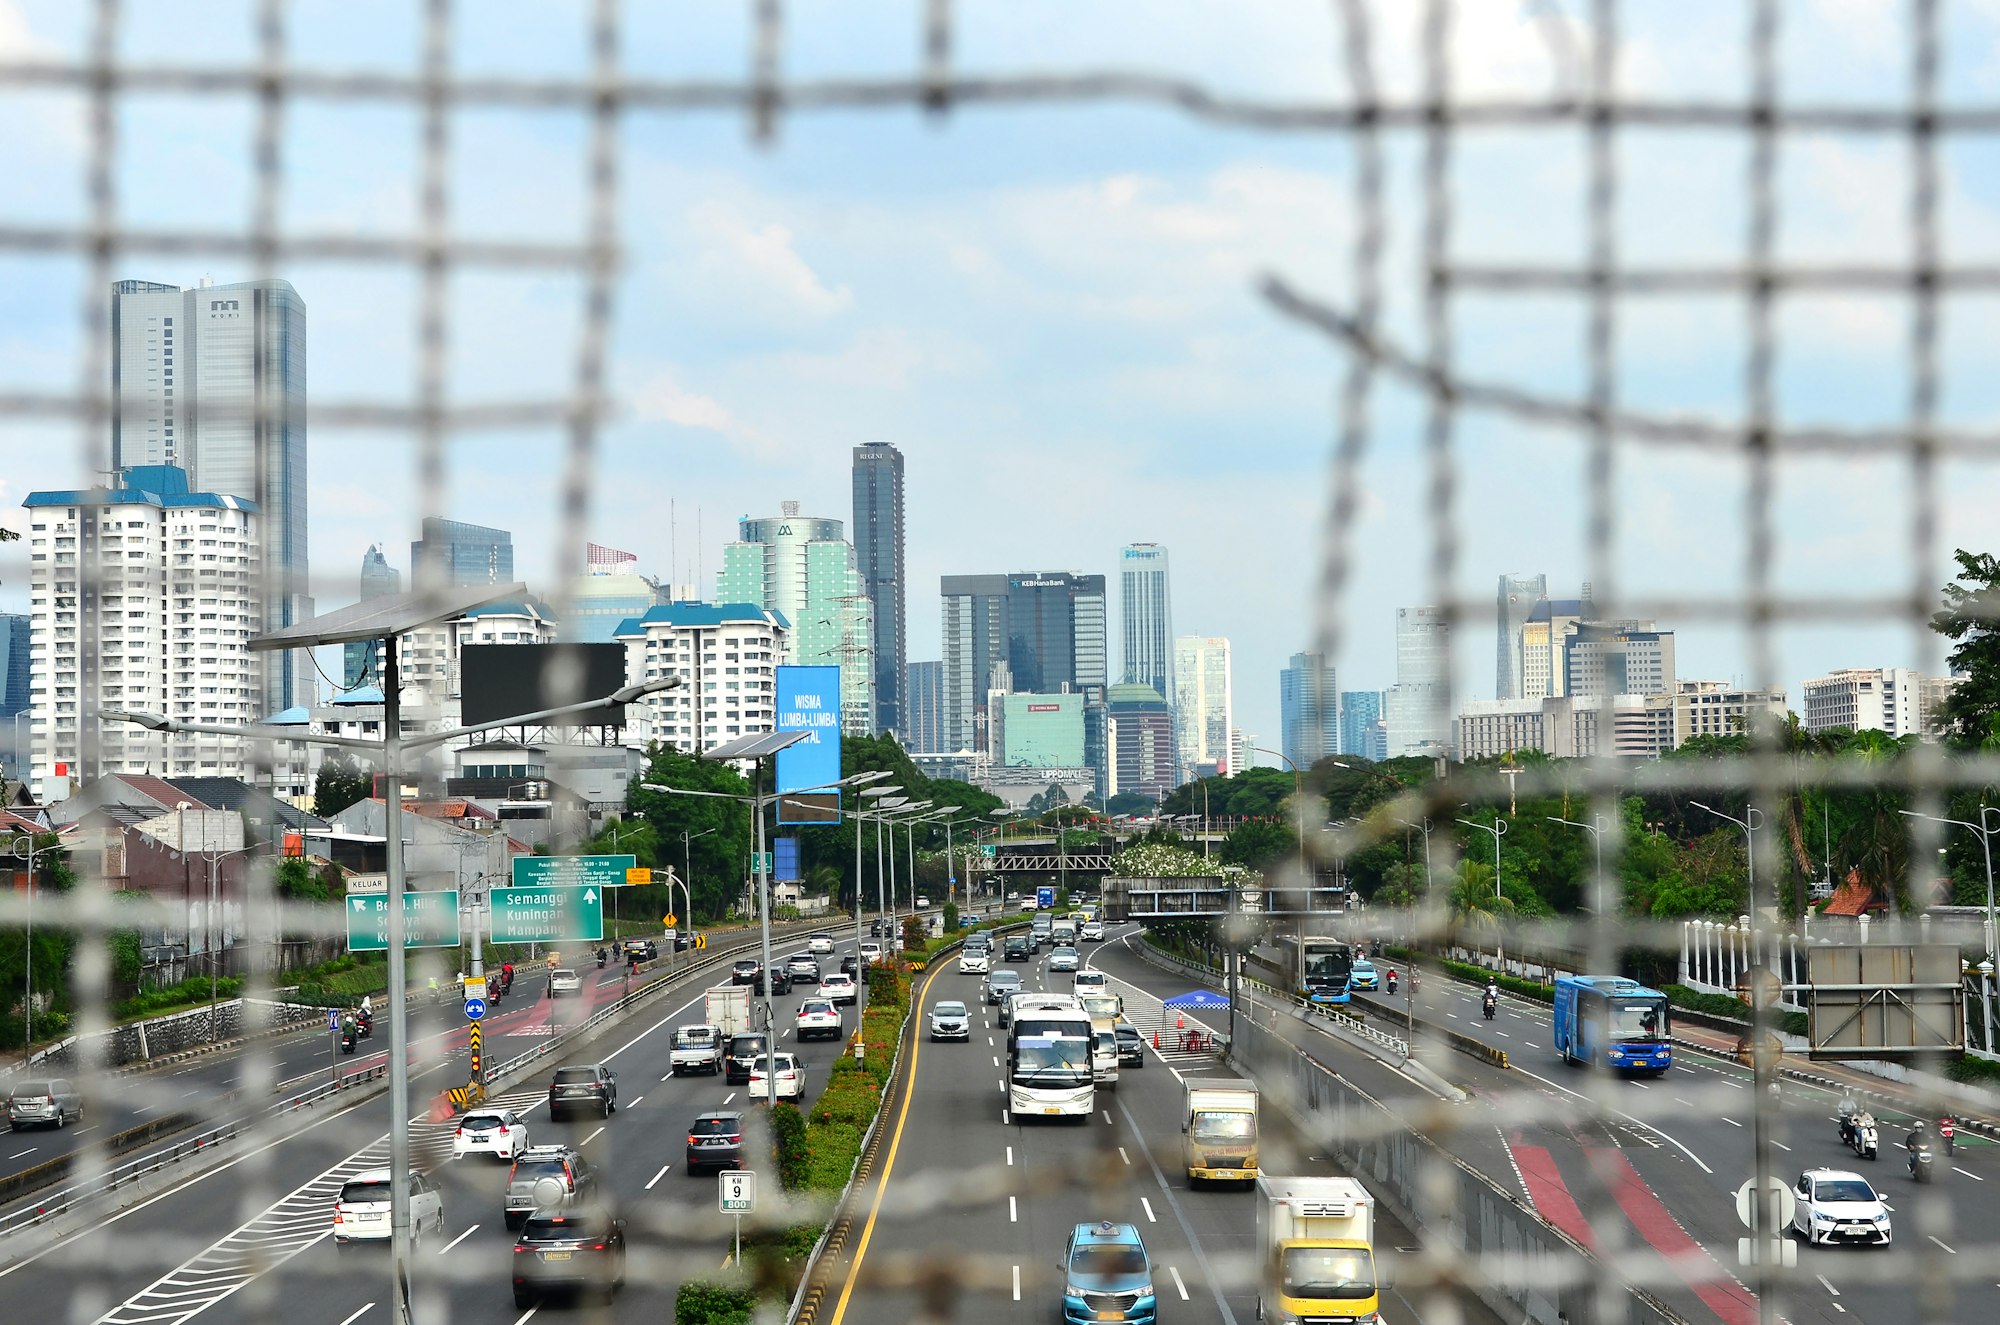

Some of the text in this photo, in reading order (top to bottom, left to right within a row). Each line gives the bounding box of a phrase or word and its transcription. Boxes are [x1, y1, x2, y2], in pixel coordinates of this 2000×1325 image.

[794, 694, 822, 709] WISMA
[779, 712, 837, 727] LUMBA-LUMBA
[352, 880, 383, 888] KELUAR
[506, 892, 567, 907] Semanggi
[507, 909, 564, 922] Kuningan
[507, 924, 565, 937] Mampang
[733, 1186, 741, 1197] 9
